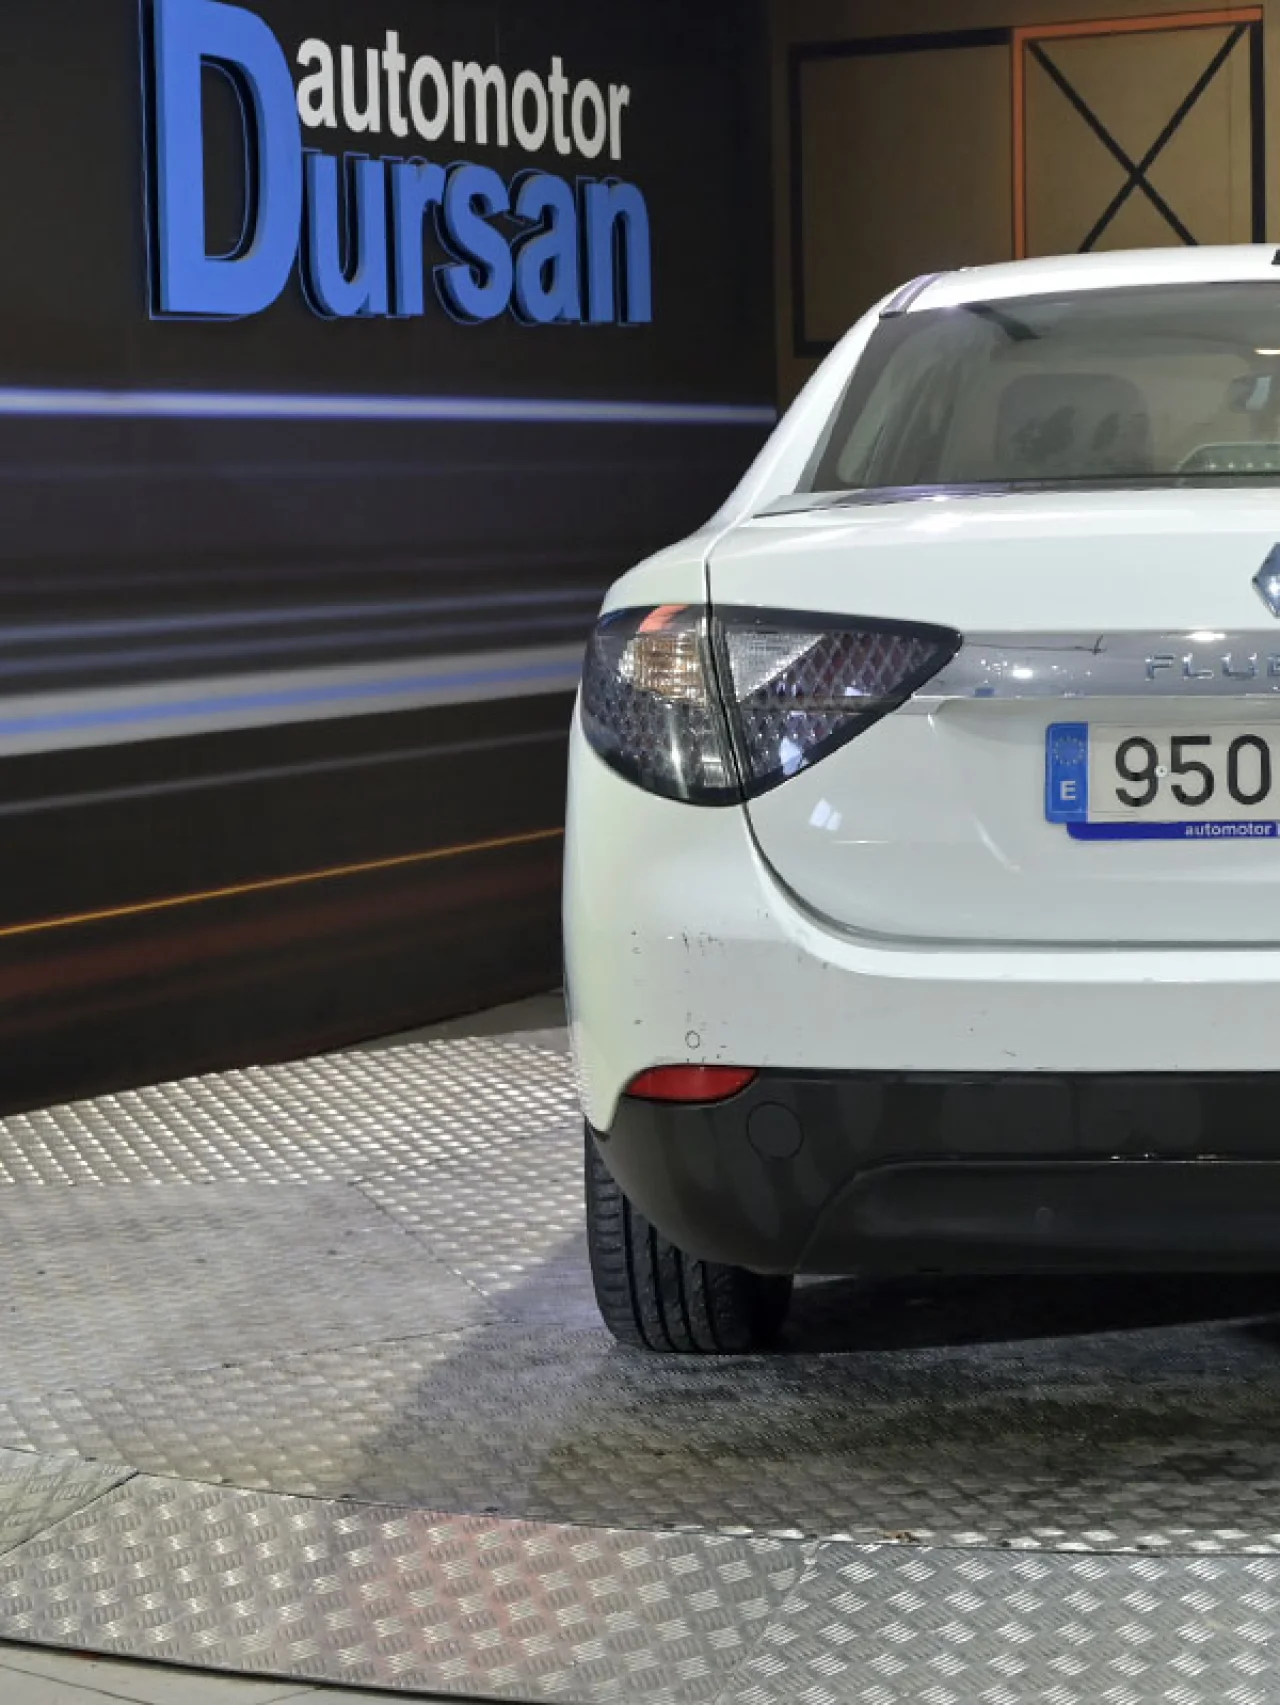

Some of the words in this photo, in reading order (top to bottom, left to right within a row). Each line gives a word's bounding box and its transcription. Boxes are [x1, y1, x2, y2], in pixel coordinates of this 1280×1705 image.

[296, 30, 630, 160] automotor
[143, 0, 652, 324] Dursan
[1060, 781, 1076, 801] E
[1185, 823, 1273, 836] automotor
